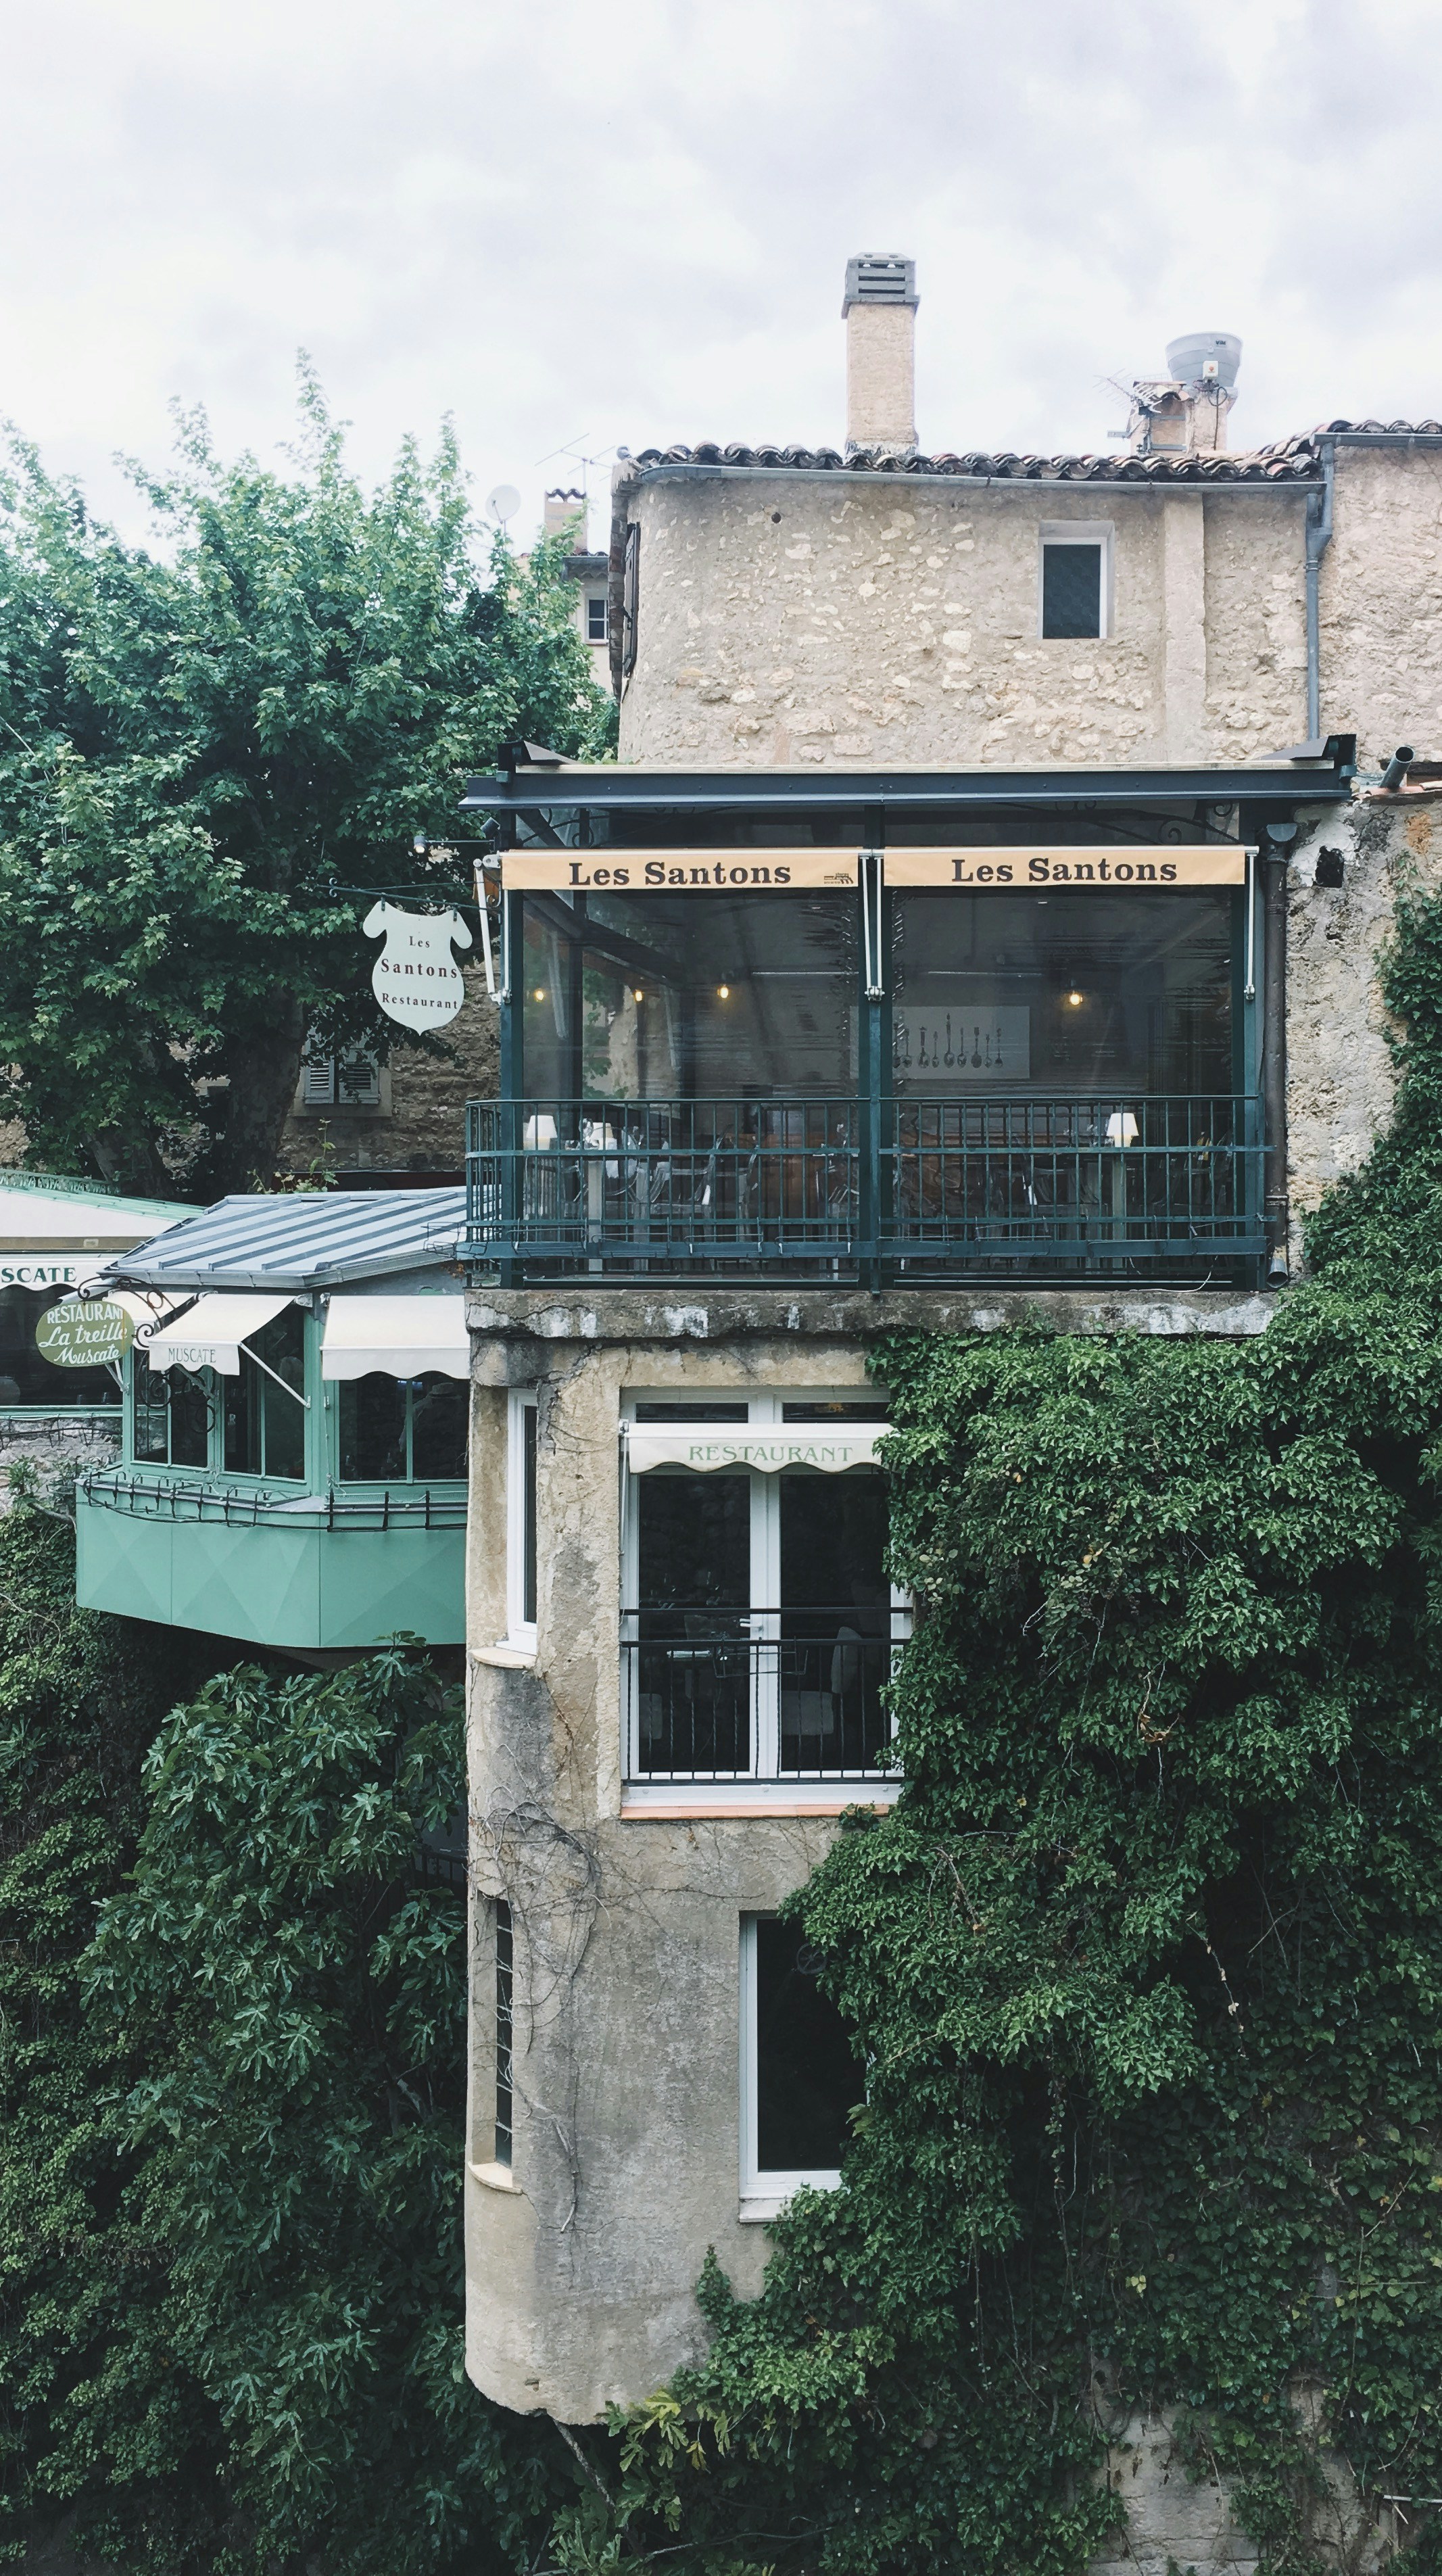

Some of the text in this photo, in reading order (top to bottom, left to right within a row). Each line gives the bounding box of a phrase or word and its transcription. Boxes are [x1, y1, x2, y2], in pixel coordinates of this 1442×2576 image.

[569, 861, 791, 886] Les Santons
[951, 857, 1178, 882] Les Santons
[409, 936, 430, 948] Les
[381, 958, 457, 978] Santons
[382, 993, 458, 1009] Restaurant
[1, 1268, 77, 1283] SCATE
[47, 1303, 124, 1324] RESTAURANT
[38, 1321, 128, 1347] La treille
[53, 1343, 120, 1364] Muscate
[168, 1347, 216, 1363] MUSCATE
[689, 1446, 853, 1462] RESTAURANT
